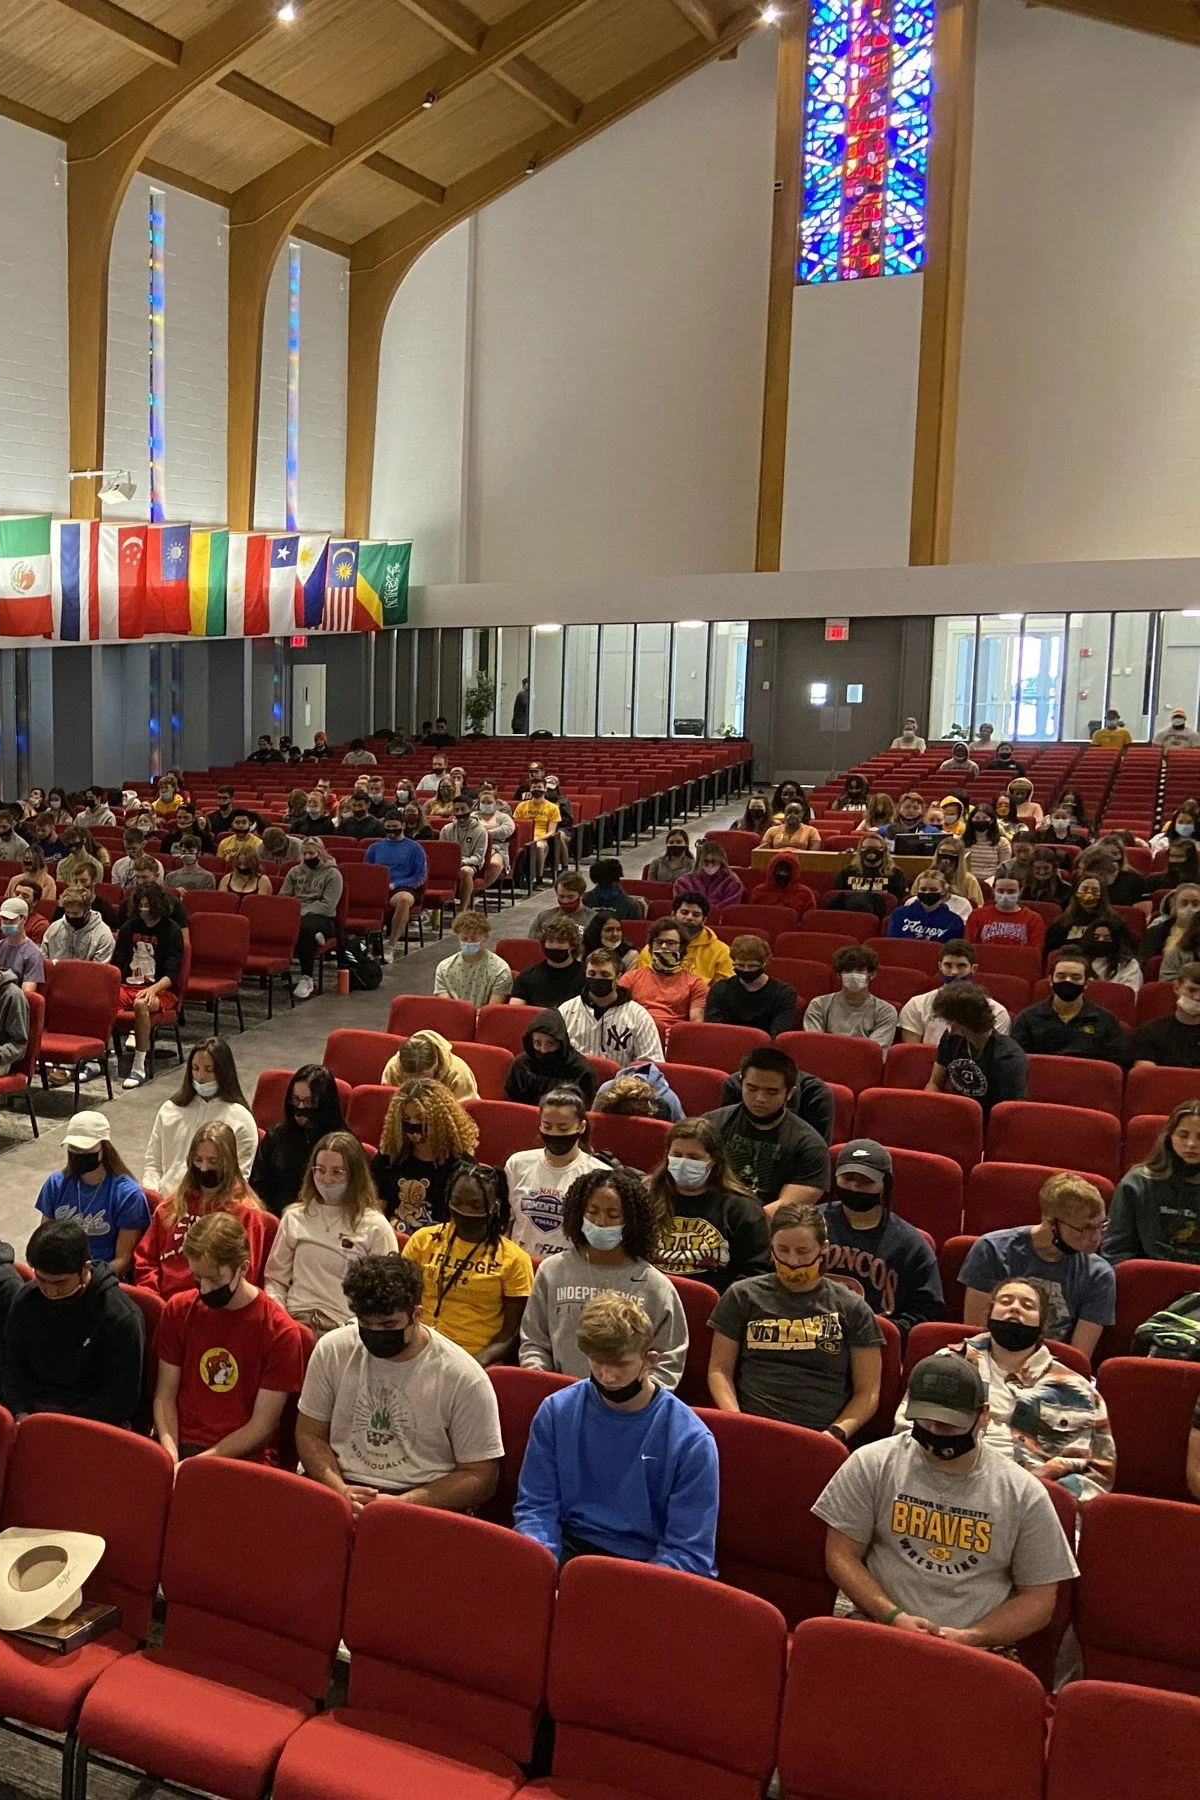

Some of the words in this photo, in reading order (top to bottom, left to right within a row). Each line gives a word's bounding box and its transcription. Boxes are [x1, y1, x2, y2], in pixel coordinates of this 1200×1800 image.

[606, 1024, 633, 1051] NY
[534, 1217, 558, 1227] FINALS
[435, 1253, 497, 1276] PLEDGE
[747, 1312, 843, 1341] OTTAWA
[898, 1493, 934, 1509] OTTAWA
[892, 1500, 992, 1554] BRAVES
[899, 1537, 979, 1575] WRESTLING
